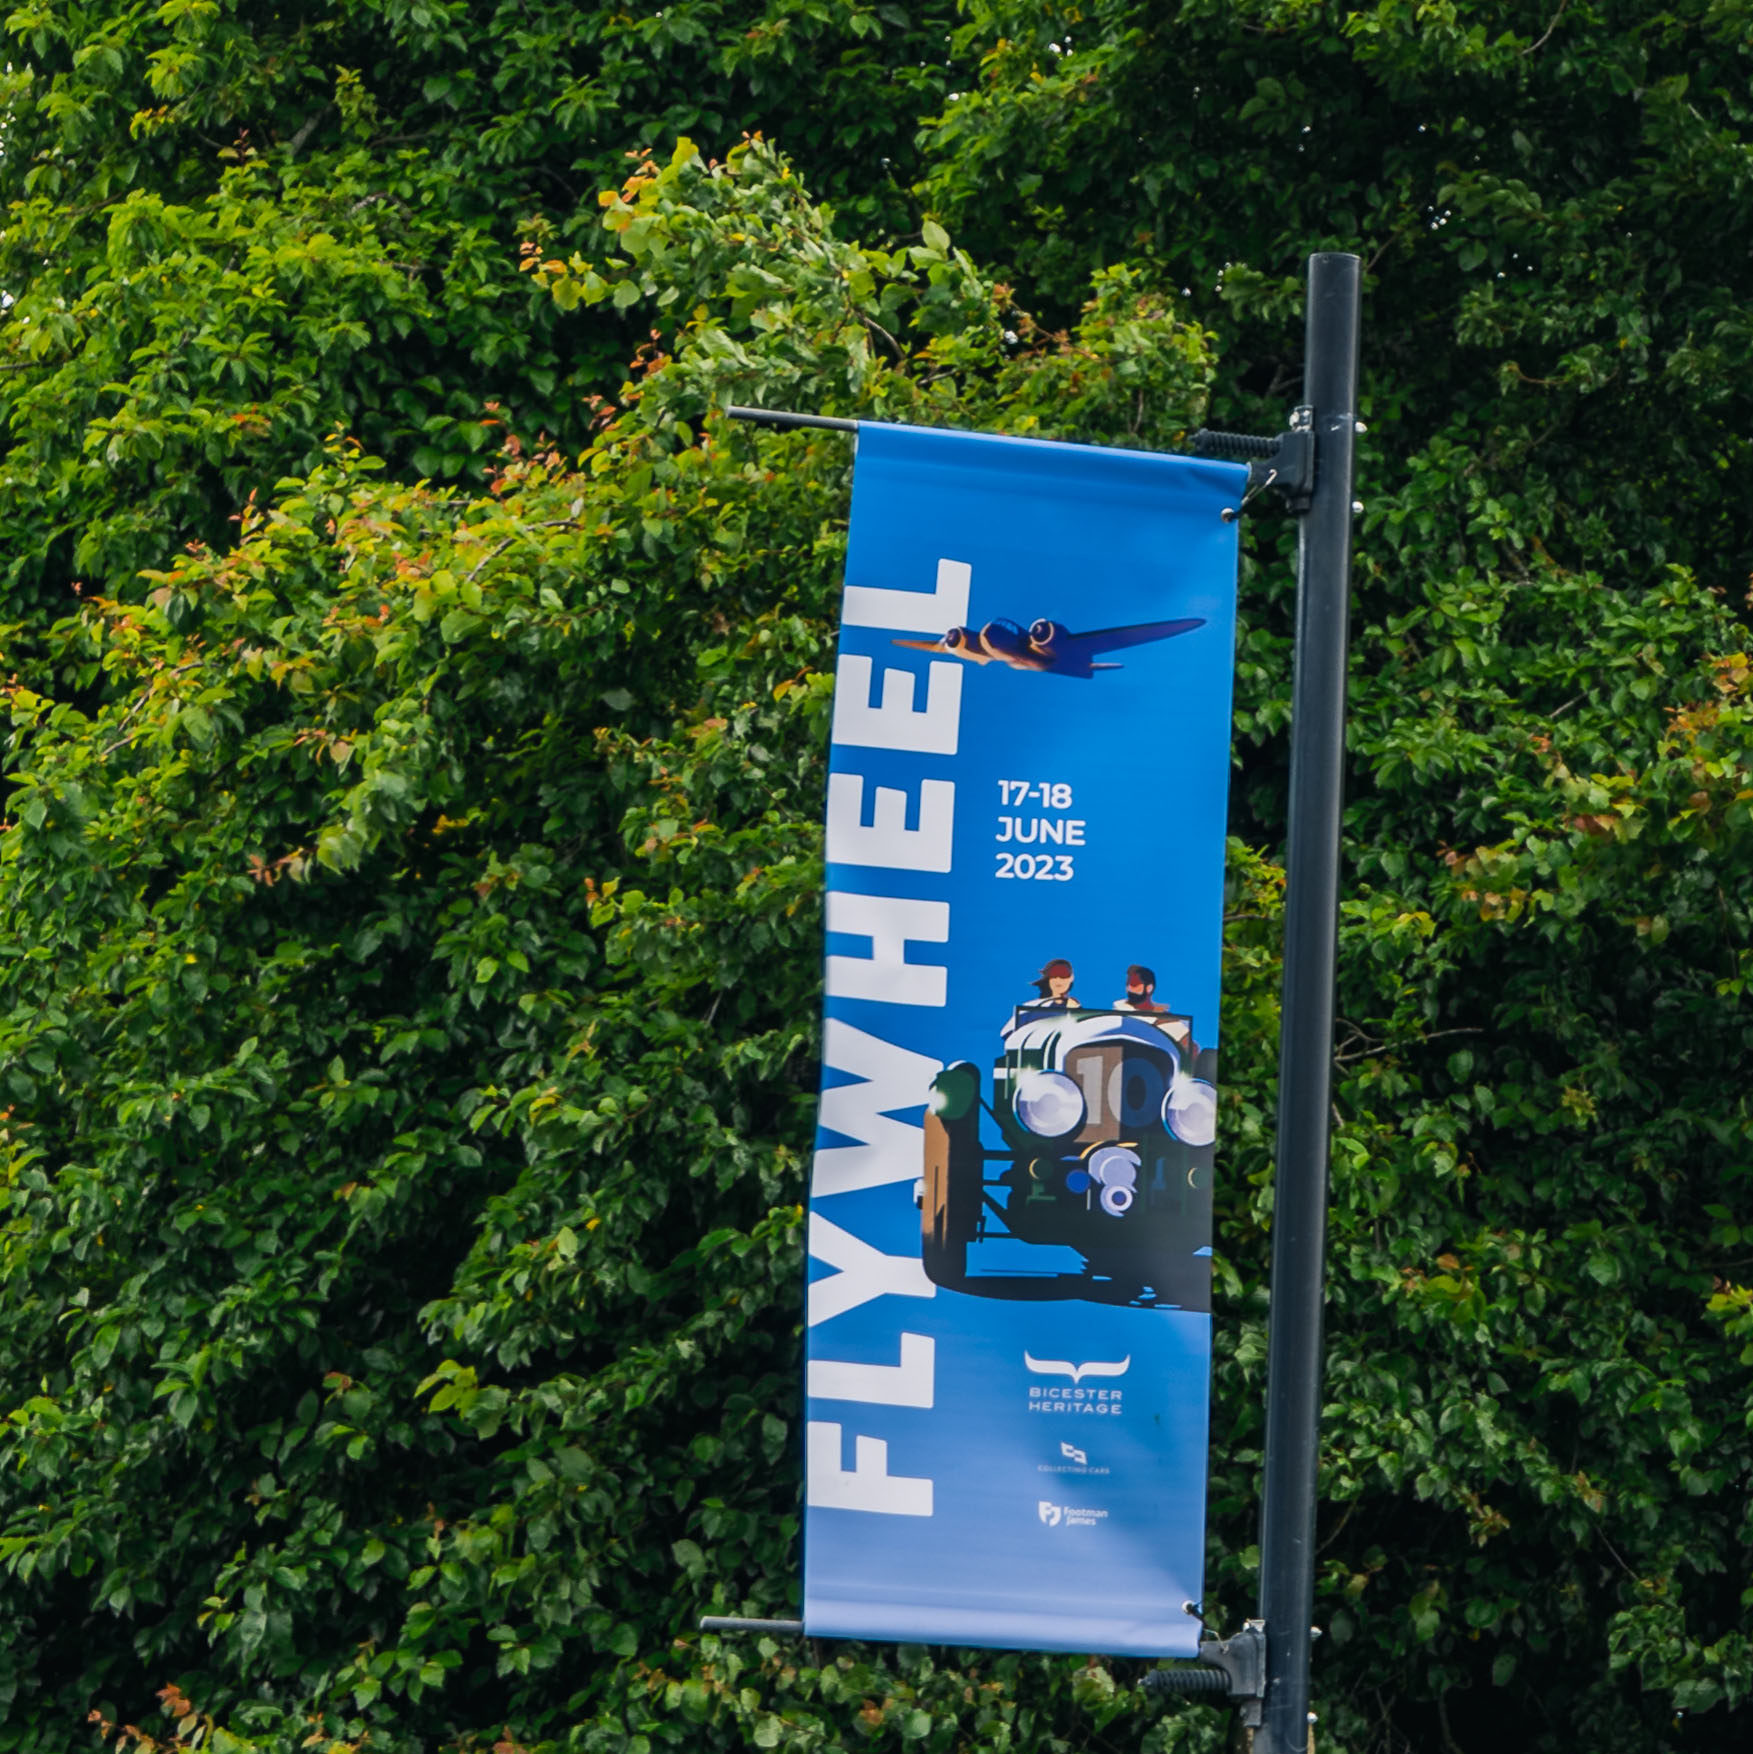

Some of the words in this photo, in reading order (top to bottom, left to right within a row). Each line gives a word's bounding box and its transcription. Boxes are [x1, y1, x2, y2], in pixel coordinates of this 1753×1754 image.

[997, 779, 1073, 810] 17-18
[995, 816, 1086, 846] JUNE
[995, 852, 1075, 881] 2023
[806, 557, 972, 1517] FLYWHEEL
[1028, 1386, 1123, 1401] BICESTER
[1028, 1401, 1123, 1415] HERITAGE
[1037, 1464, 1087, 1474] COLLECTING
[1089, 1466, 1110, 1475] CARS
[1063, 1506, 1109, 1518] Footman
[1065, 1515, 1097, 1528] James
